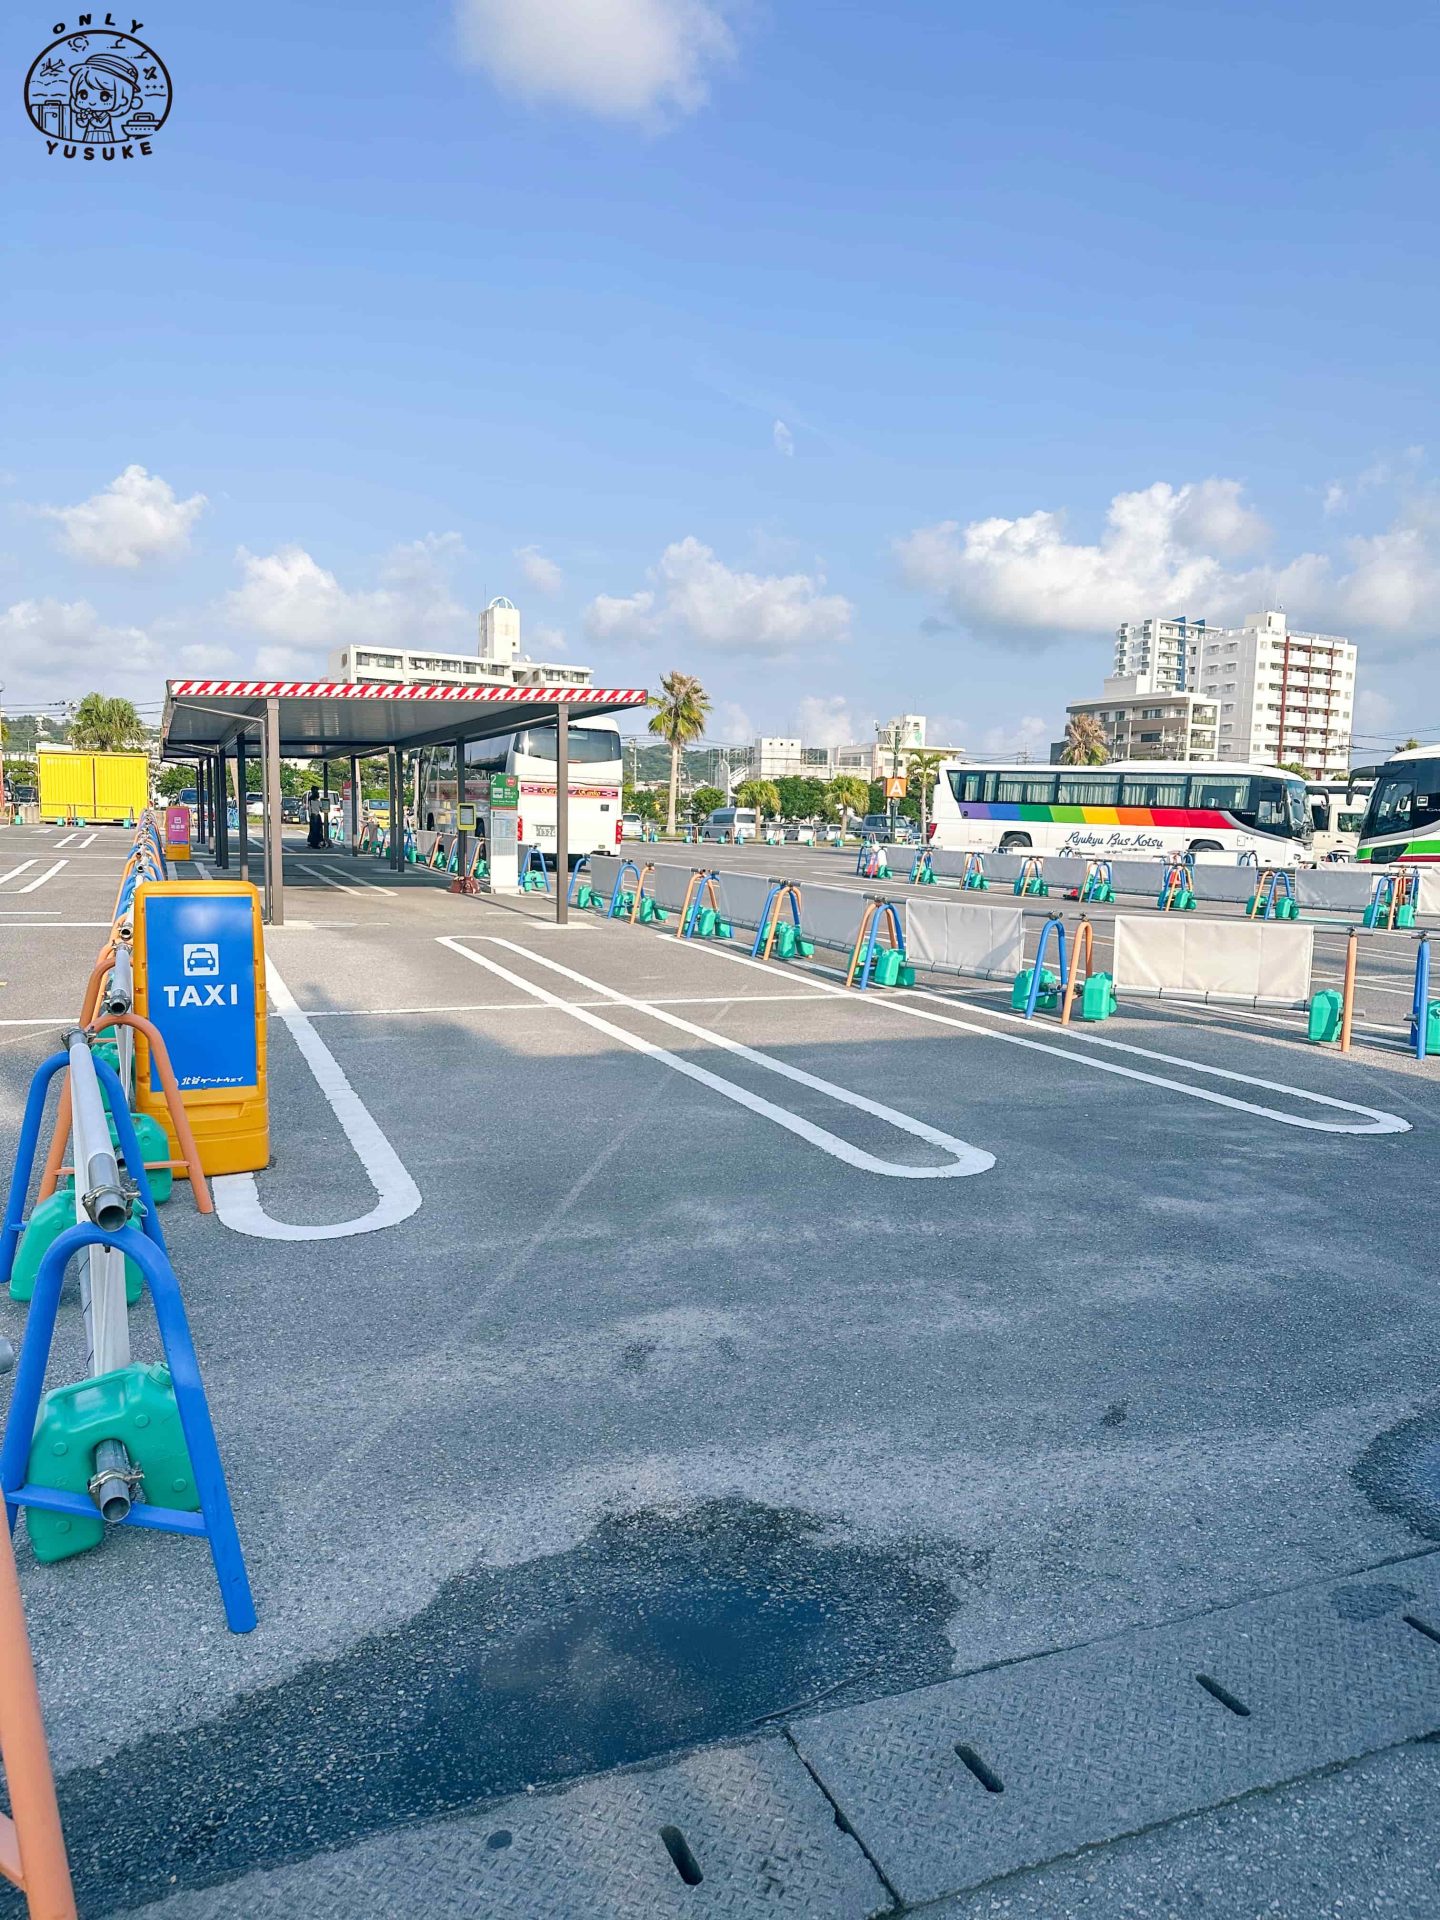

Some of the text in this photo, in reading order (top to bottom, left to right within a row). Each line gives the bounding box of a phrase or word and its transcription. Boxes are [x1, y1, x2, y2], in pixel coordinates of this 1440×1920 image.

[490, 774, 497, 785] 2
[890, 779, 903, 796] A
[1065, 831, 1164, 850] Ryukyu Bus Kotsu
[163, 983, 238, 1007] TAXI
